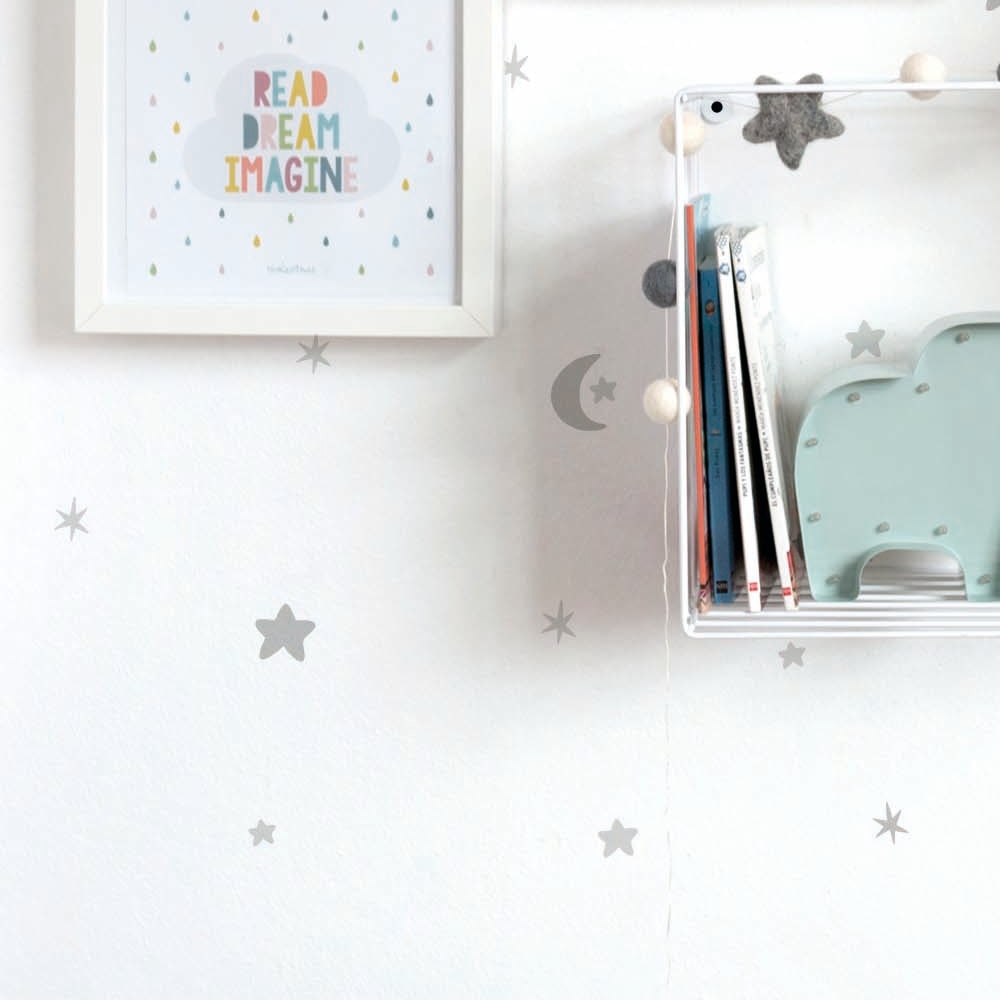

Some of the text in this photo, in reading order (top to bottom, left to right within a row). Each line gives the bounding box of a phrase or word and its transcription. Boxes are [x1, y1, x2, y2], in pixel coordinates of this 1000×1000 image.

[253, 70, 328, 107] READ
[242, 112, 340, 150] DREAM
[224, 155, 359, 193] IMAGINE
